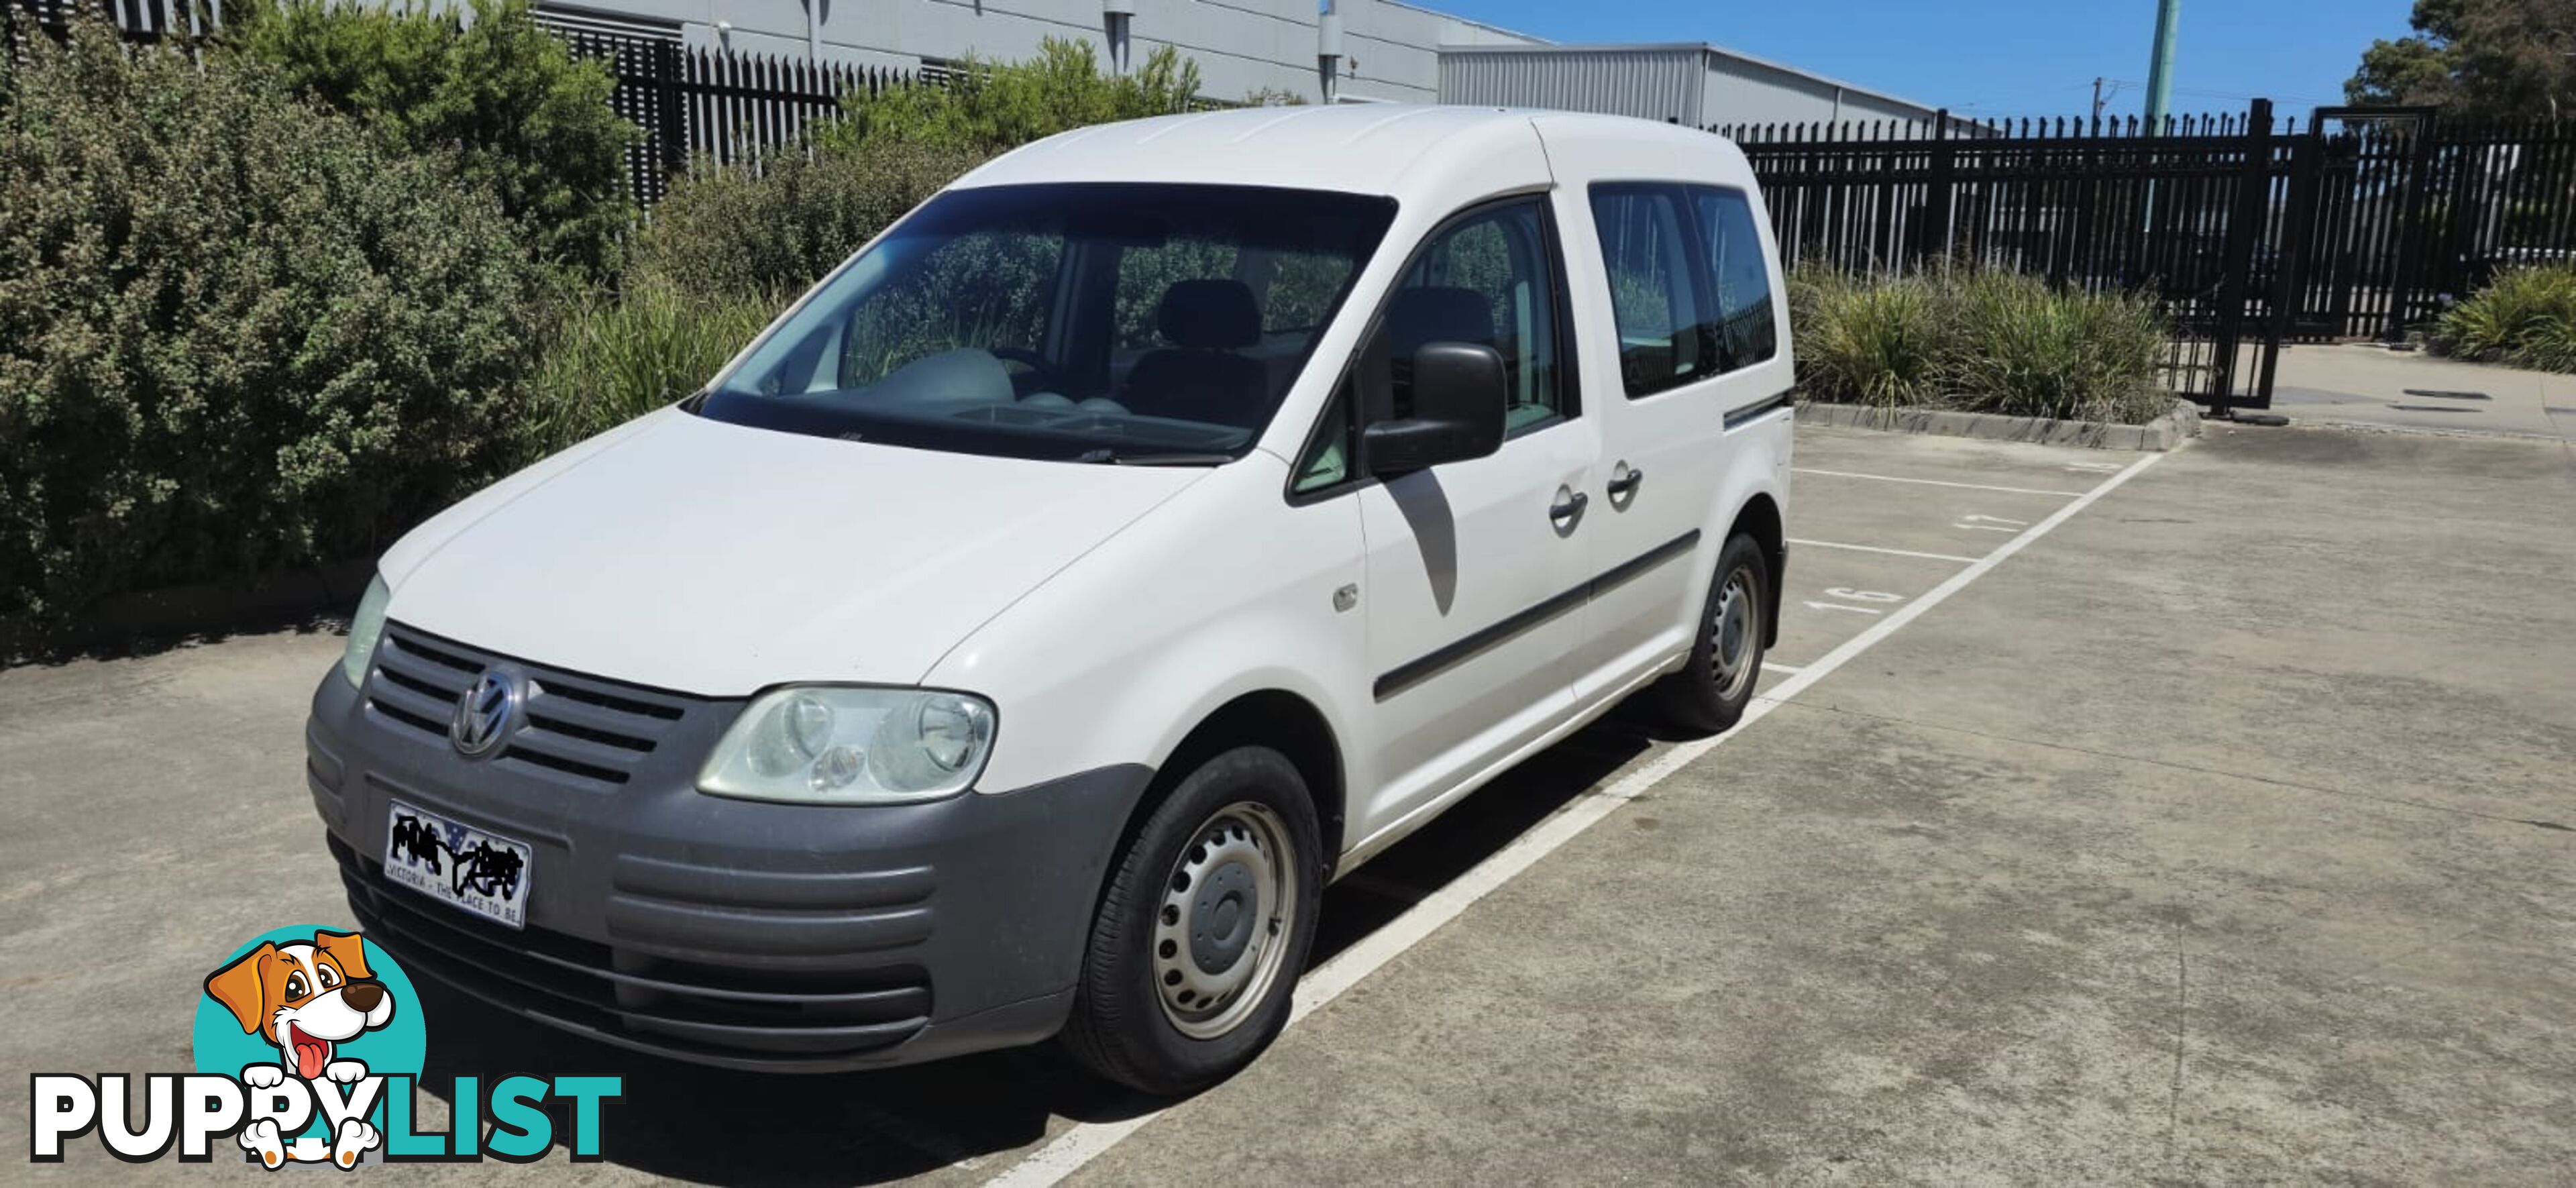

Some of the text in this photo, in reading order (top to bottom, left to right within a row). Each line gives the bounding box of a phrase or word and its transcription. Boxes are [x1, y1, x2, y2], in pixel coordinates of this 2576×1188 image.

[1953, 515, 2029, 532] 17
[1803, 587, 1907, 614] 16
[389, 864, 426, 887] VICTORIA
[437, 882, 451, 900] THE
[488, 901, 500, 916] TO
[505, 907, 516, 922] BE
